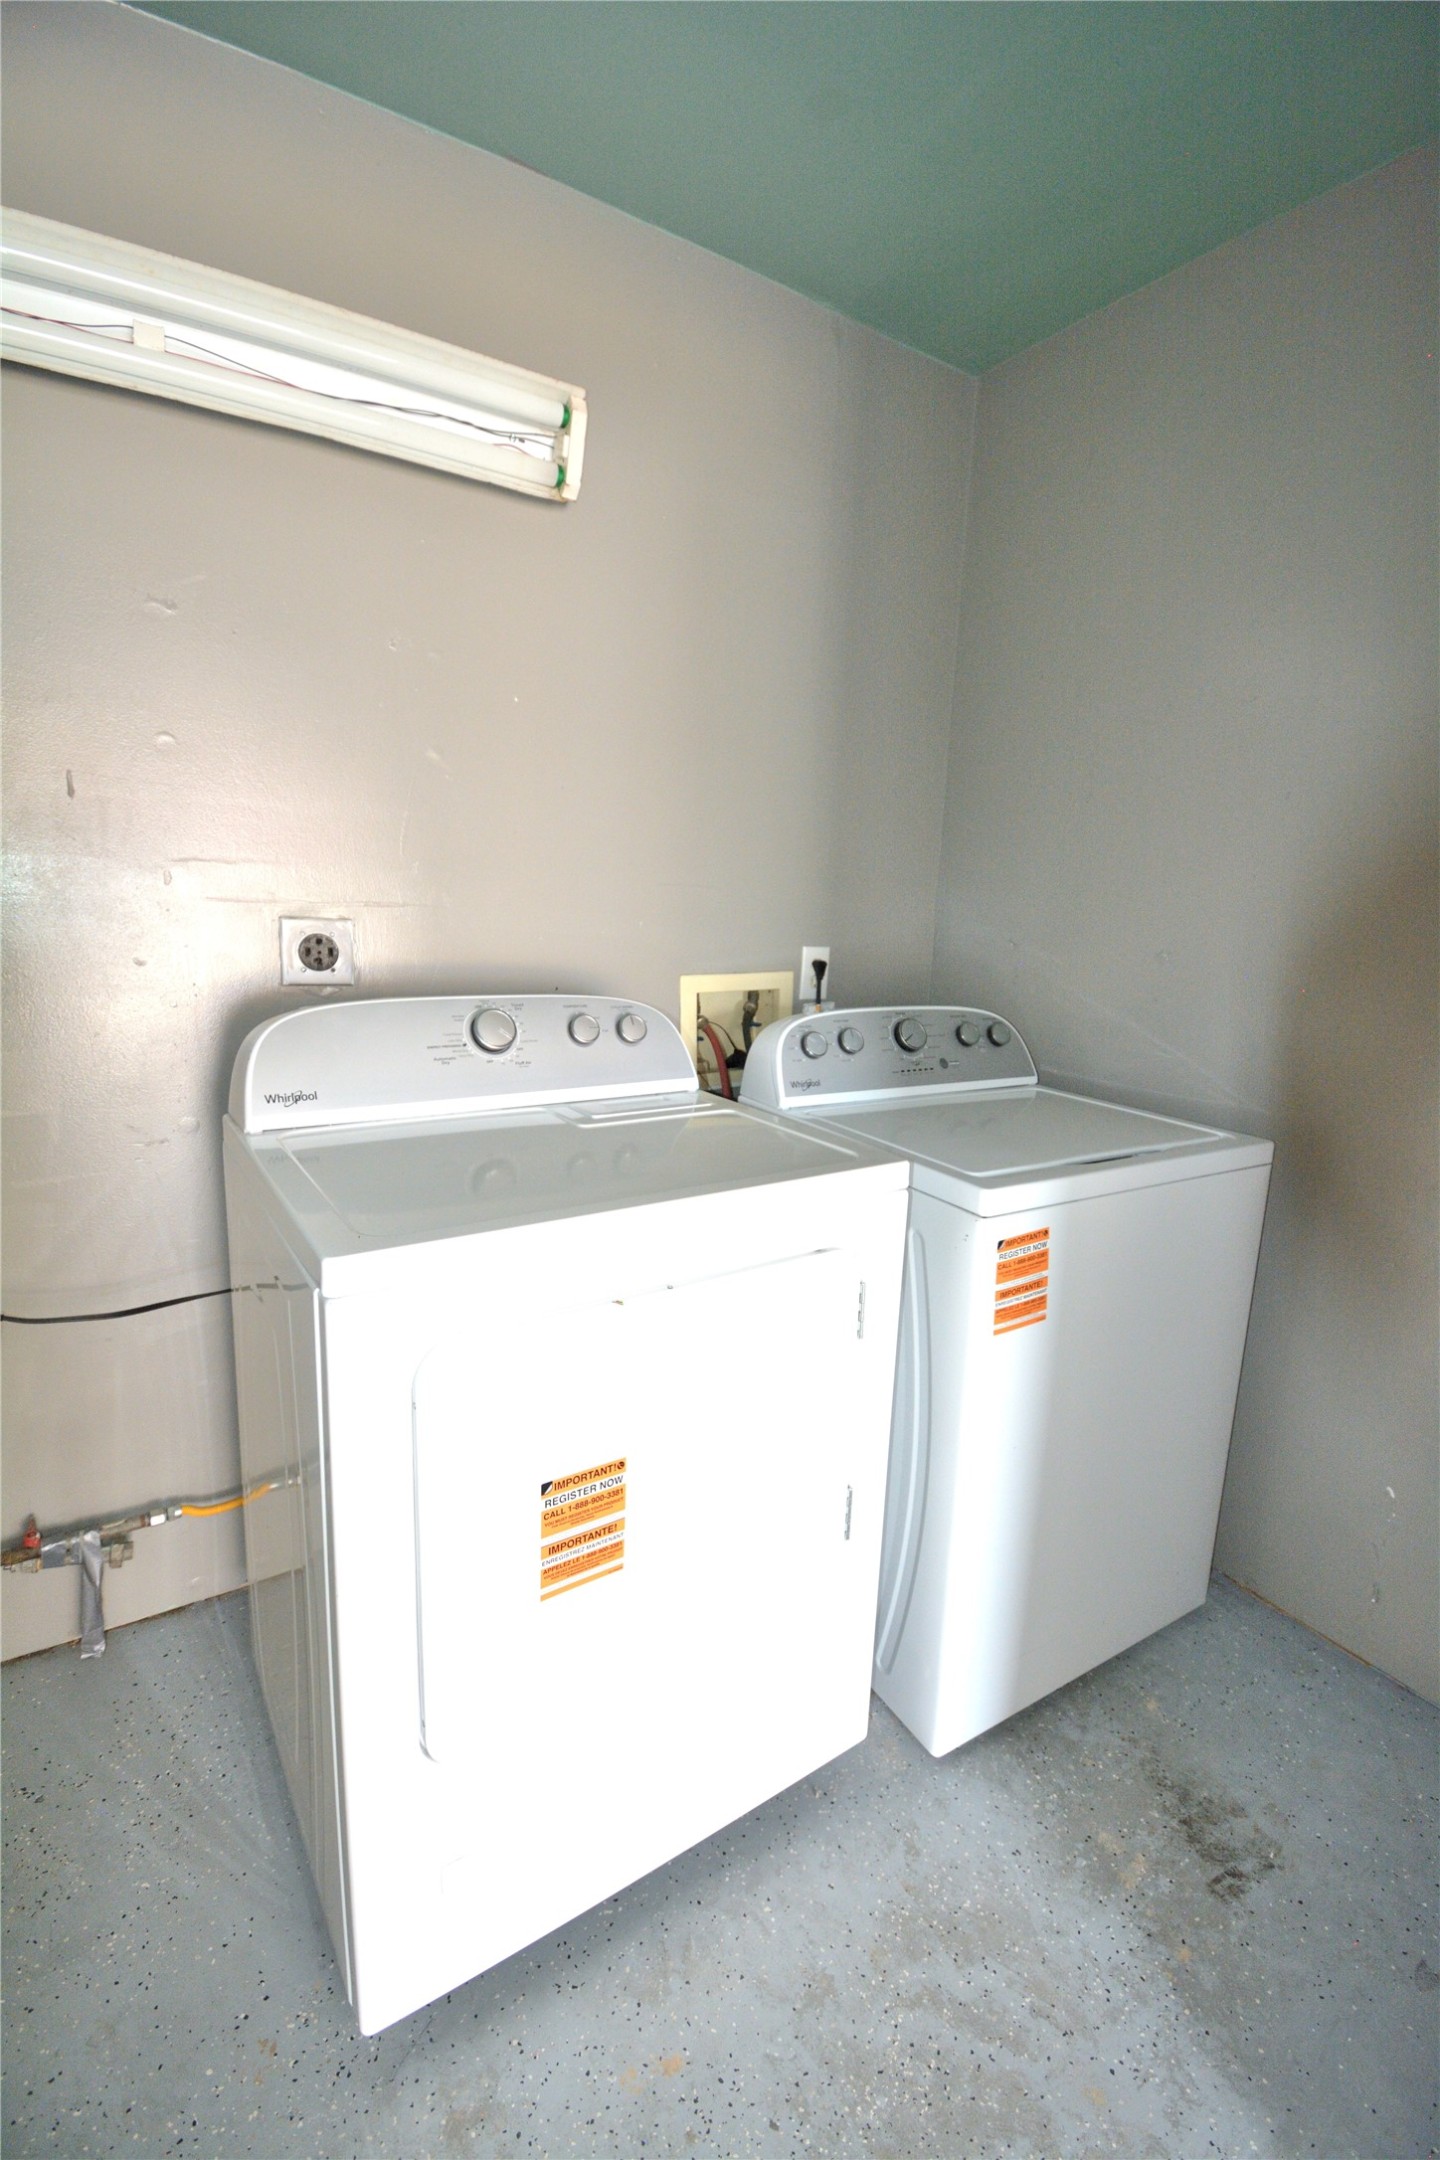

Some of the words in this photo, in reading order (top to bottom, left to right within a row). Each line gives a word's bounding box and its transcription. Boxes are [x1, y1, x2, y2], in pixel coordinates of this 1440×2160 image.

[264, 1091, 318, 1107] Whirlpool
[790, 1079, 821, 1091] Whirlpool
[999, 1246, 1032, 1261] REGISTER
[1033, 1241, 1049, 1252] NOW
[545, 1484, 597, 1509] REGISTER
[600, 1475, 624, 1490] NOW
[554, 1463, 617, 1491] IMPORTANT!
[543, 1508, 566, 1521] CALL
[568, 1488, 624, 1512] 1-888-900-3381
[542, 1547, 585, 1568] ENREGISTREZ
[586, 1532, 625, 1550] MAINTENANT
[548, 1523, 618, 1556] IMPORTANTE!
